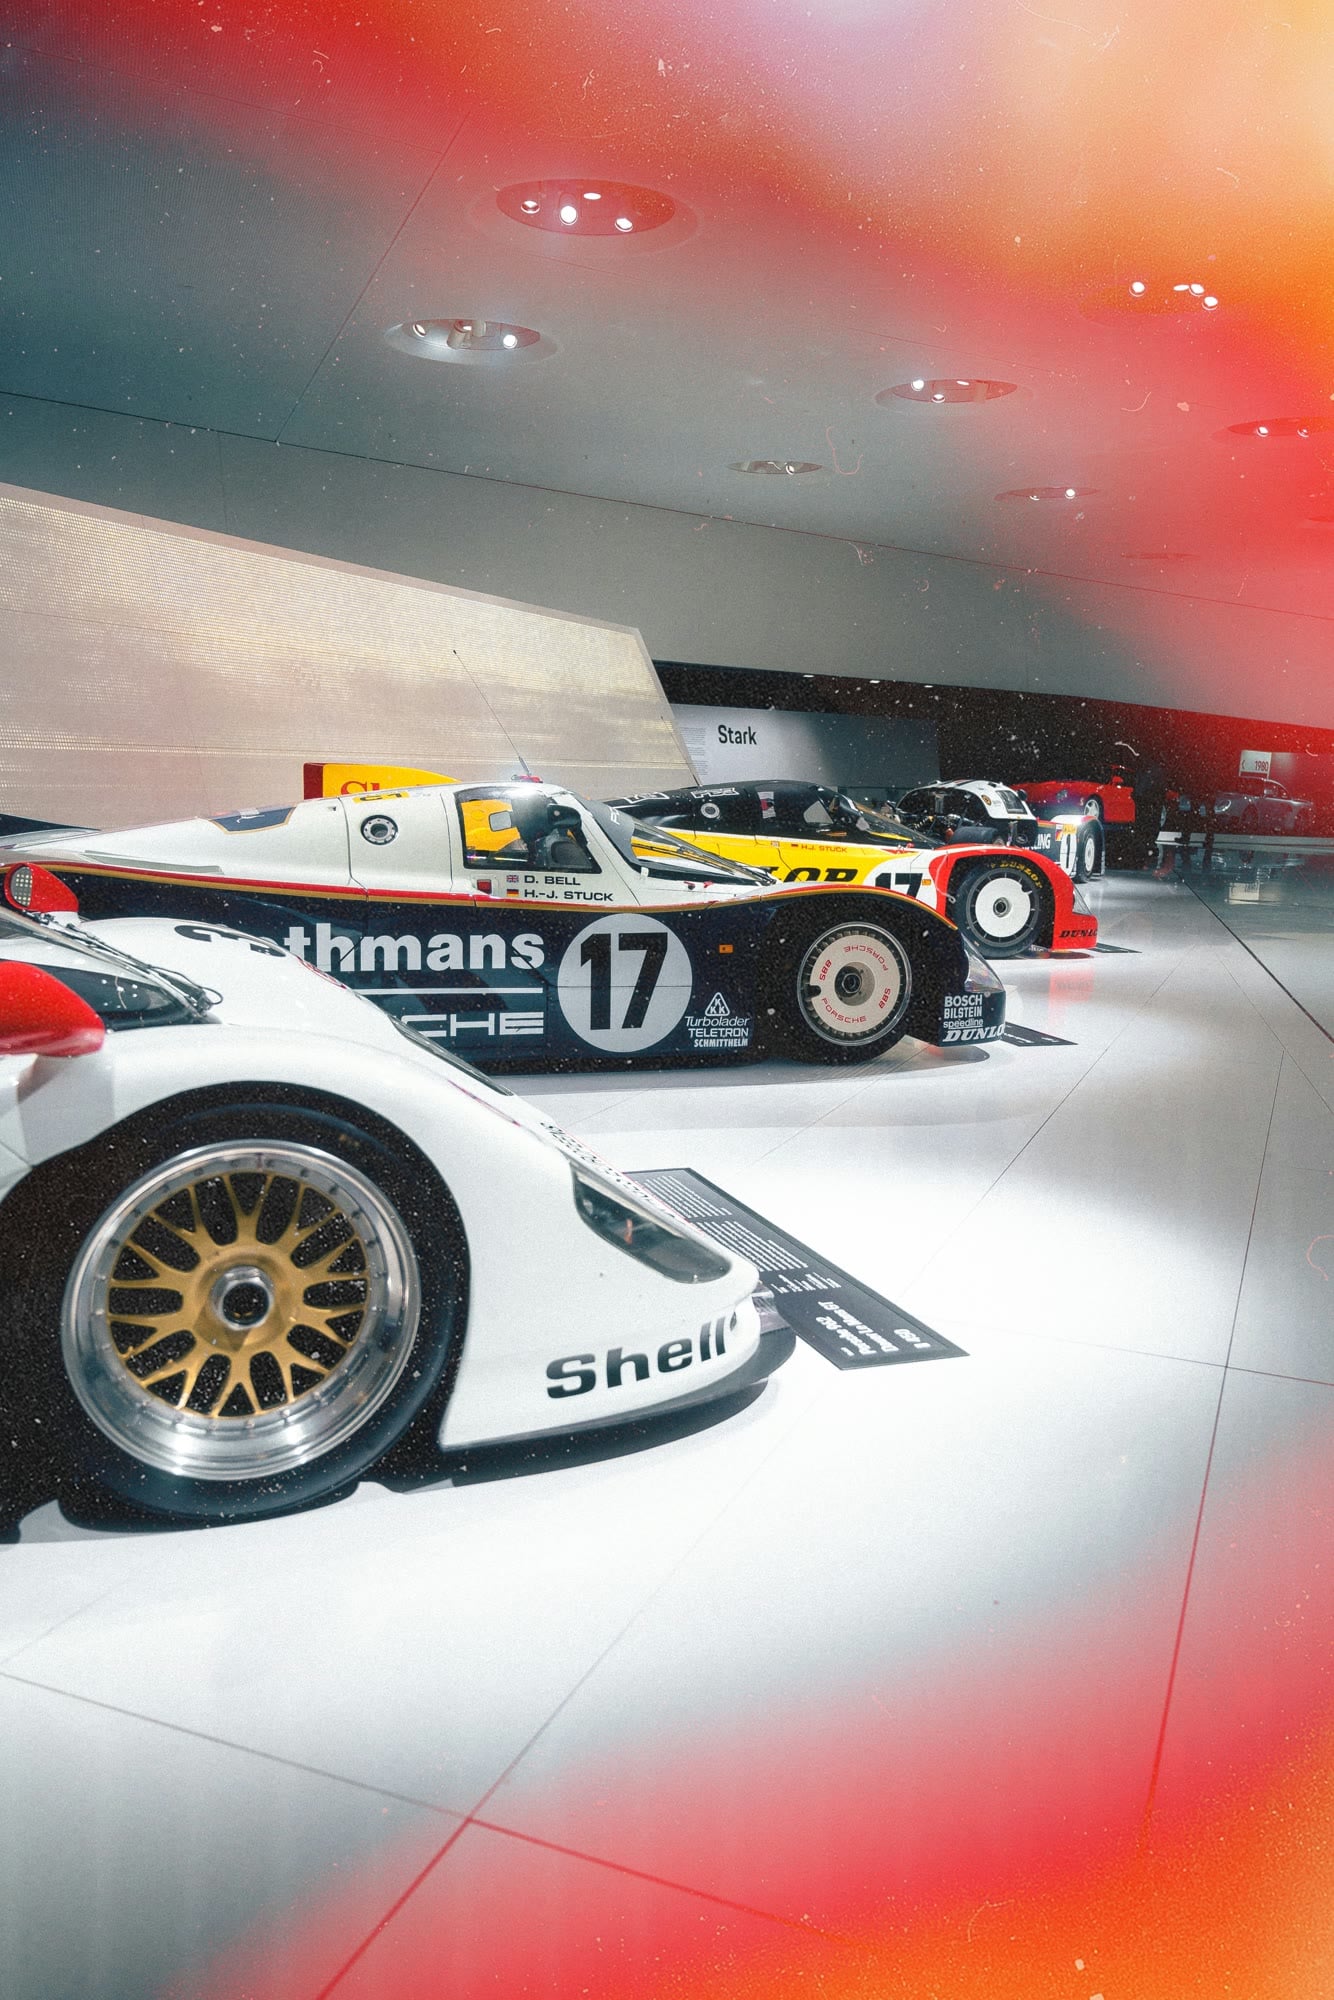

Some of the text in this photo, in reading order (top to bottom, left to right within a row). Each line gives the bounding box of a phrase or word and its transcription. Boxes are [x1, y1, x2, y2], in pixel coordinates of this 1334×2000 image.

[717, 724, 757, 745] Stark
[1254, 760, 1269, 772] 1980
[524, 875, 581, 886] D. BELL
[1000, 860, 1044, 889] DUNLOP
[524, 889, 614, 902] H.-J. STUCK
[282, 922, 545, 972] thmans
[843, 944, 889, 972] PORSCHE
[819, 959, 833, 981] BBS
[580, 932, 668, 1030] 17
[878, 987, 891, 1009] BBS
[944, 994, 983, 1007] BOSCH
[821, 997, 867, 1024] PORSCHE
[943, 1006, 983, 1019] BILSTEIN
[684, 1015, 751, 1027] Turbolader
[943, 1018, 984, 1030] speedline
[687, 1027, 749, 1038] TELETRON
[693, 1037, 749, 1048] SCHMITTHELM
[546, 1316, 726, 1399] Shell
